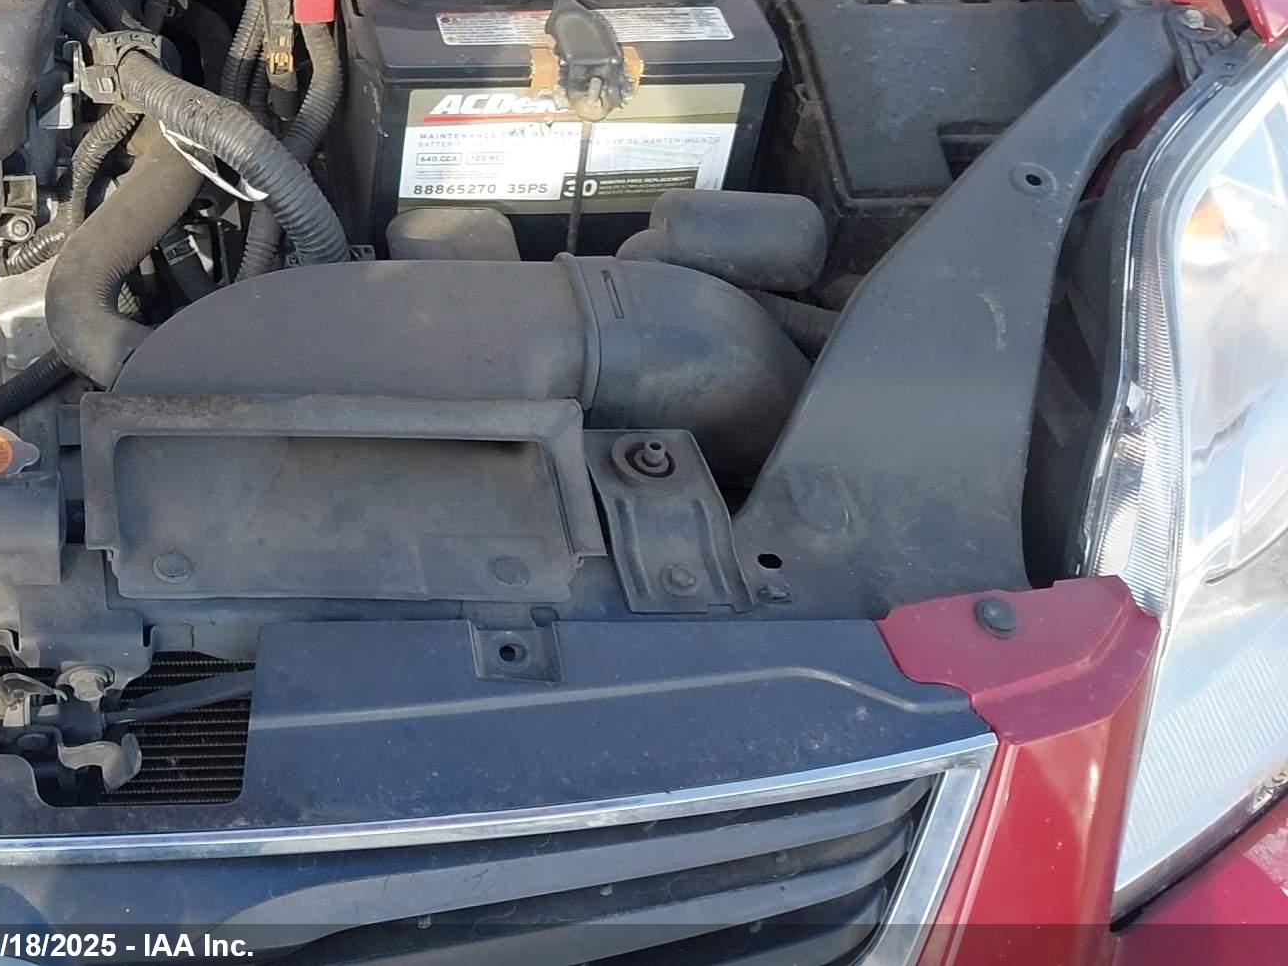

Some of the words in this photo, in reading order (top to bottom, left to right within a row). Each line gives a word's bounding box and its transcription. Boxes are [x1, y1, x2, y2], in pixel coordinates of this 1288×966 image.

[430, 94, 569, 115] ACDel
[413, 184, 497, 195] 88865270
[506, 183, 548, 194] 35PS
